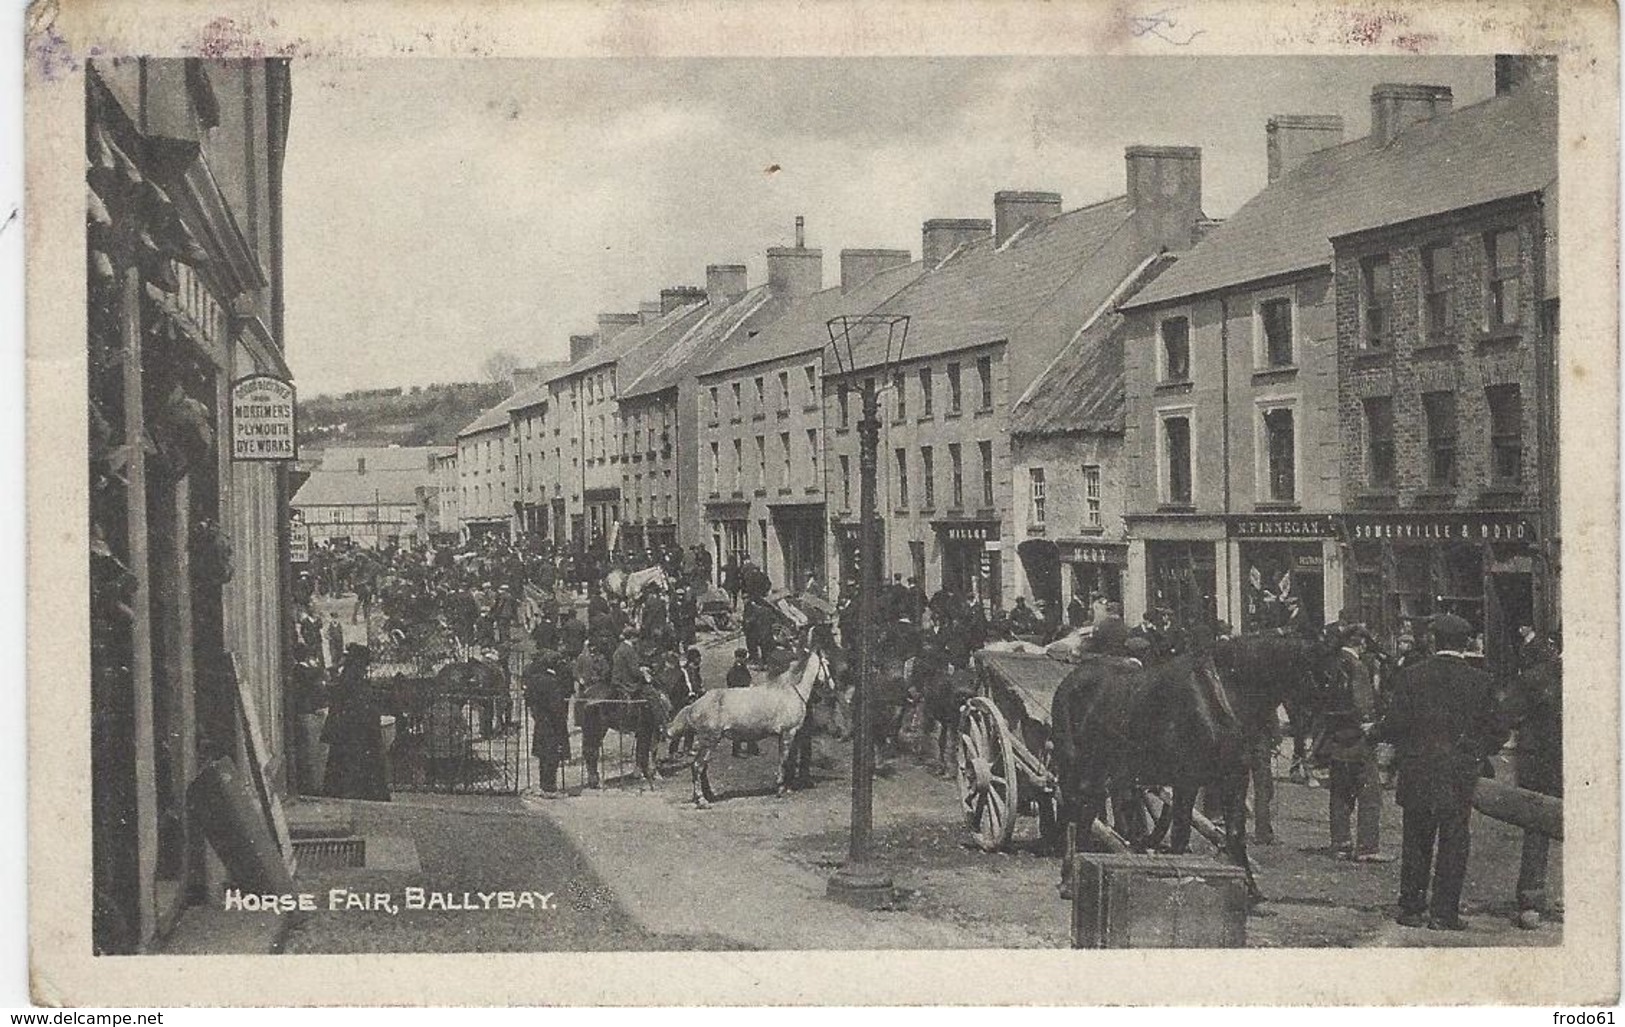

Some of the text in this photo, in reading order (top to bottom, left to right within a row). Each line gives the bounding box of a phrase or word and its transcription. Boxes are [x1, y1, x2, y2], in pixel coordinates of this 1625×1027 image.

[237, 423, 289, 436] PLYMOUTH
[236, 439, 291, 453] DYE WORKS
[1355, 524, 1451, 539] SOMERVILLE
[1461, 524, 1469, 538] &
